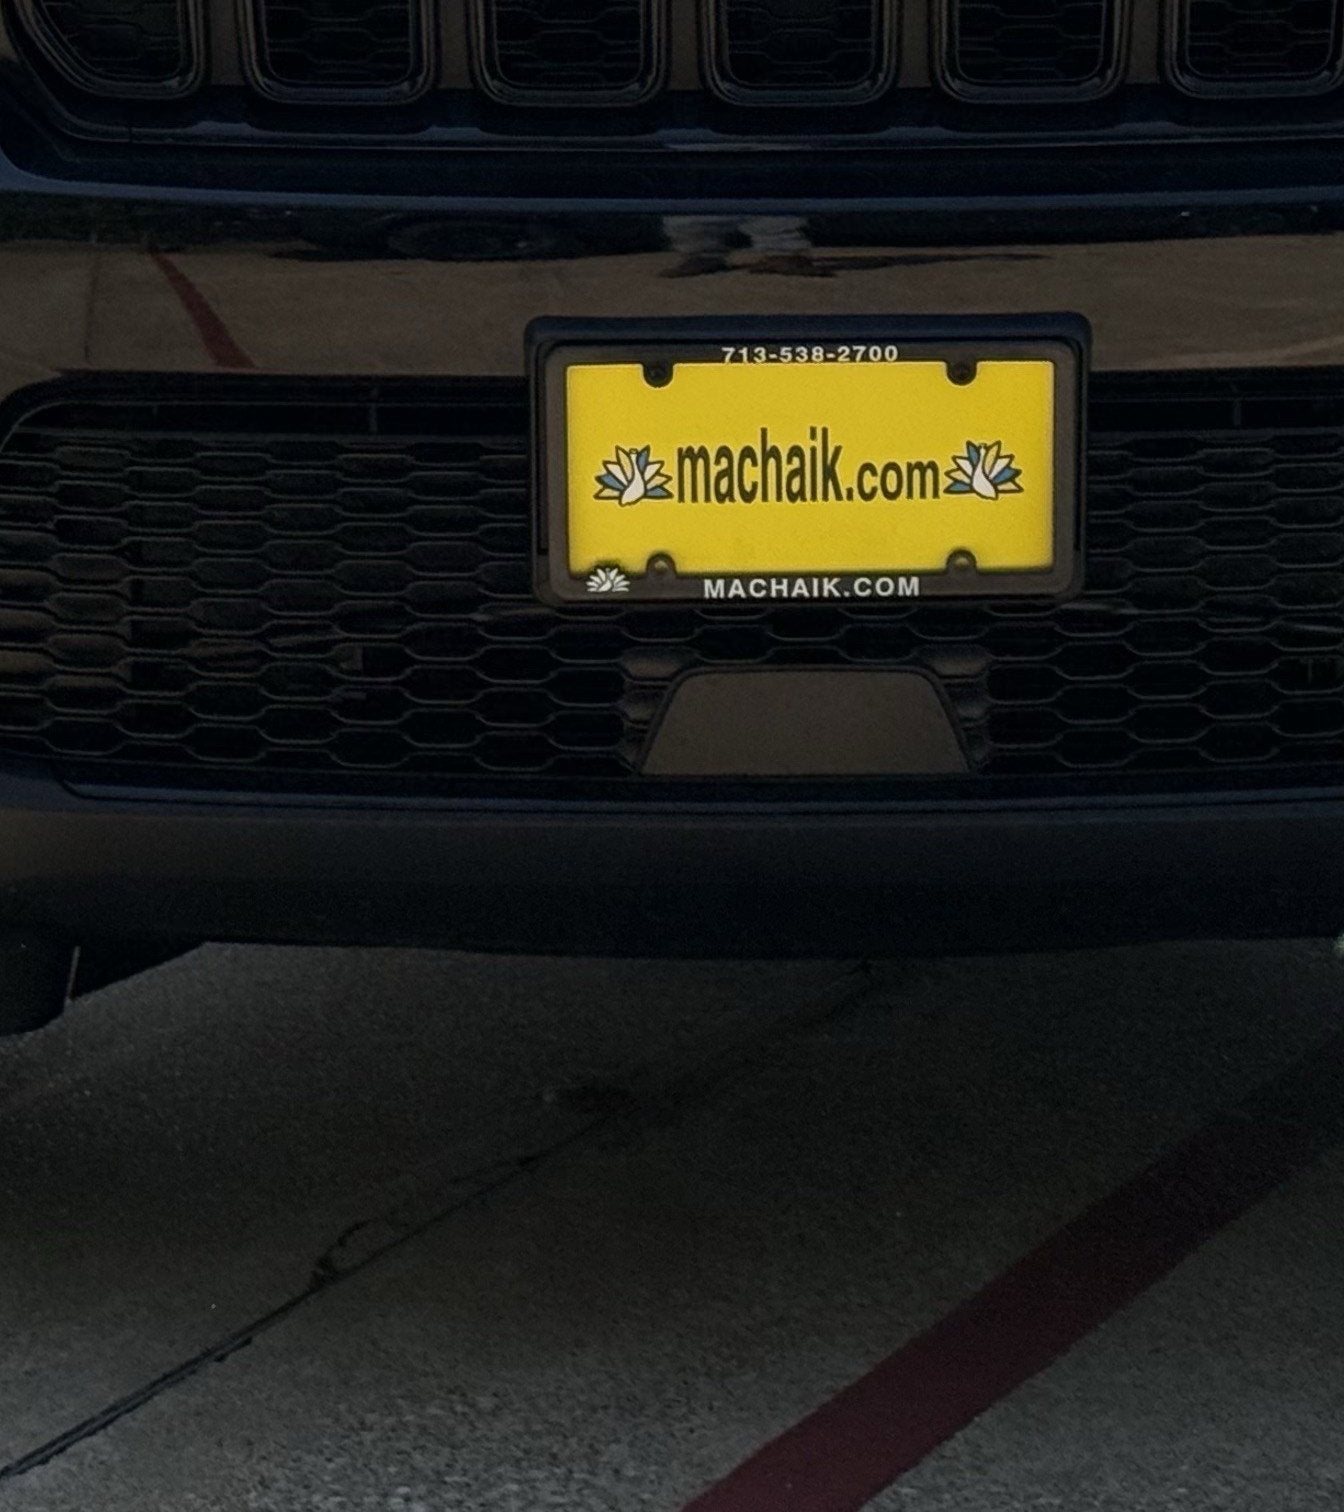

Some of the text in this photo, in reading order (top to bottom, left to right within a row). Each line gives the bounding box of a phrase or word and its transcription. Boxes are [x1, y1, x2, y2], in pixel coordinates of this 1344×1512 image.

[721, 346, 899, 363] 713-538-2700
[676, 426, 941, 504] machaik.com
[703, 576, 920, 598] MACHAIK.COM
